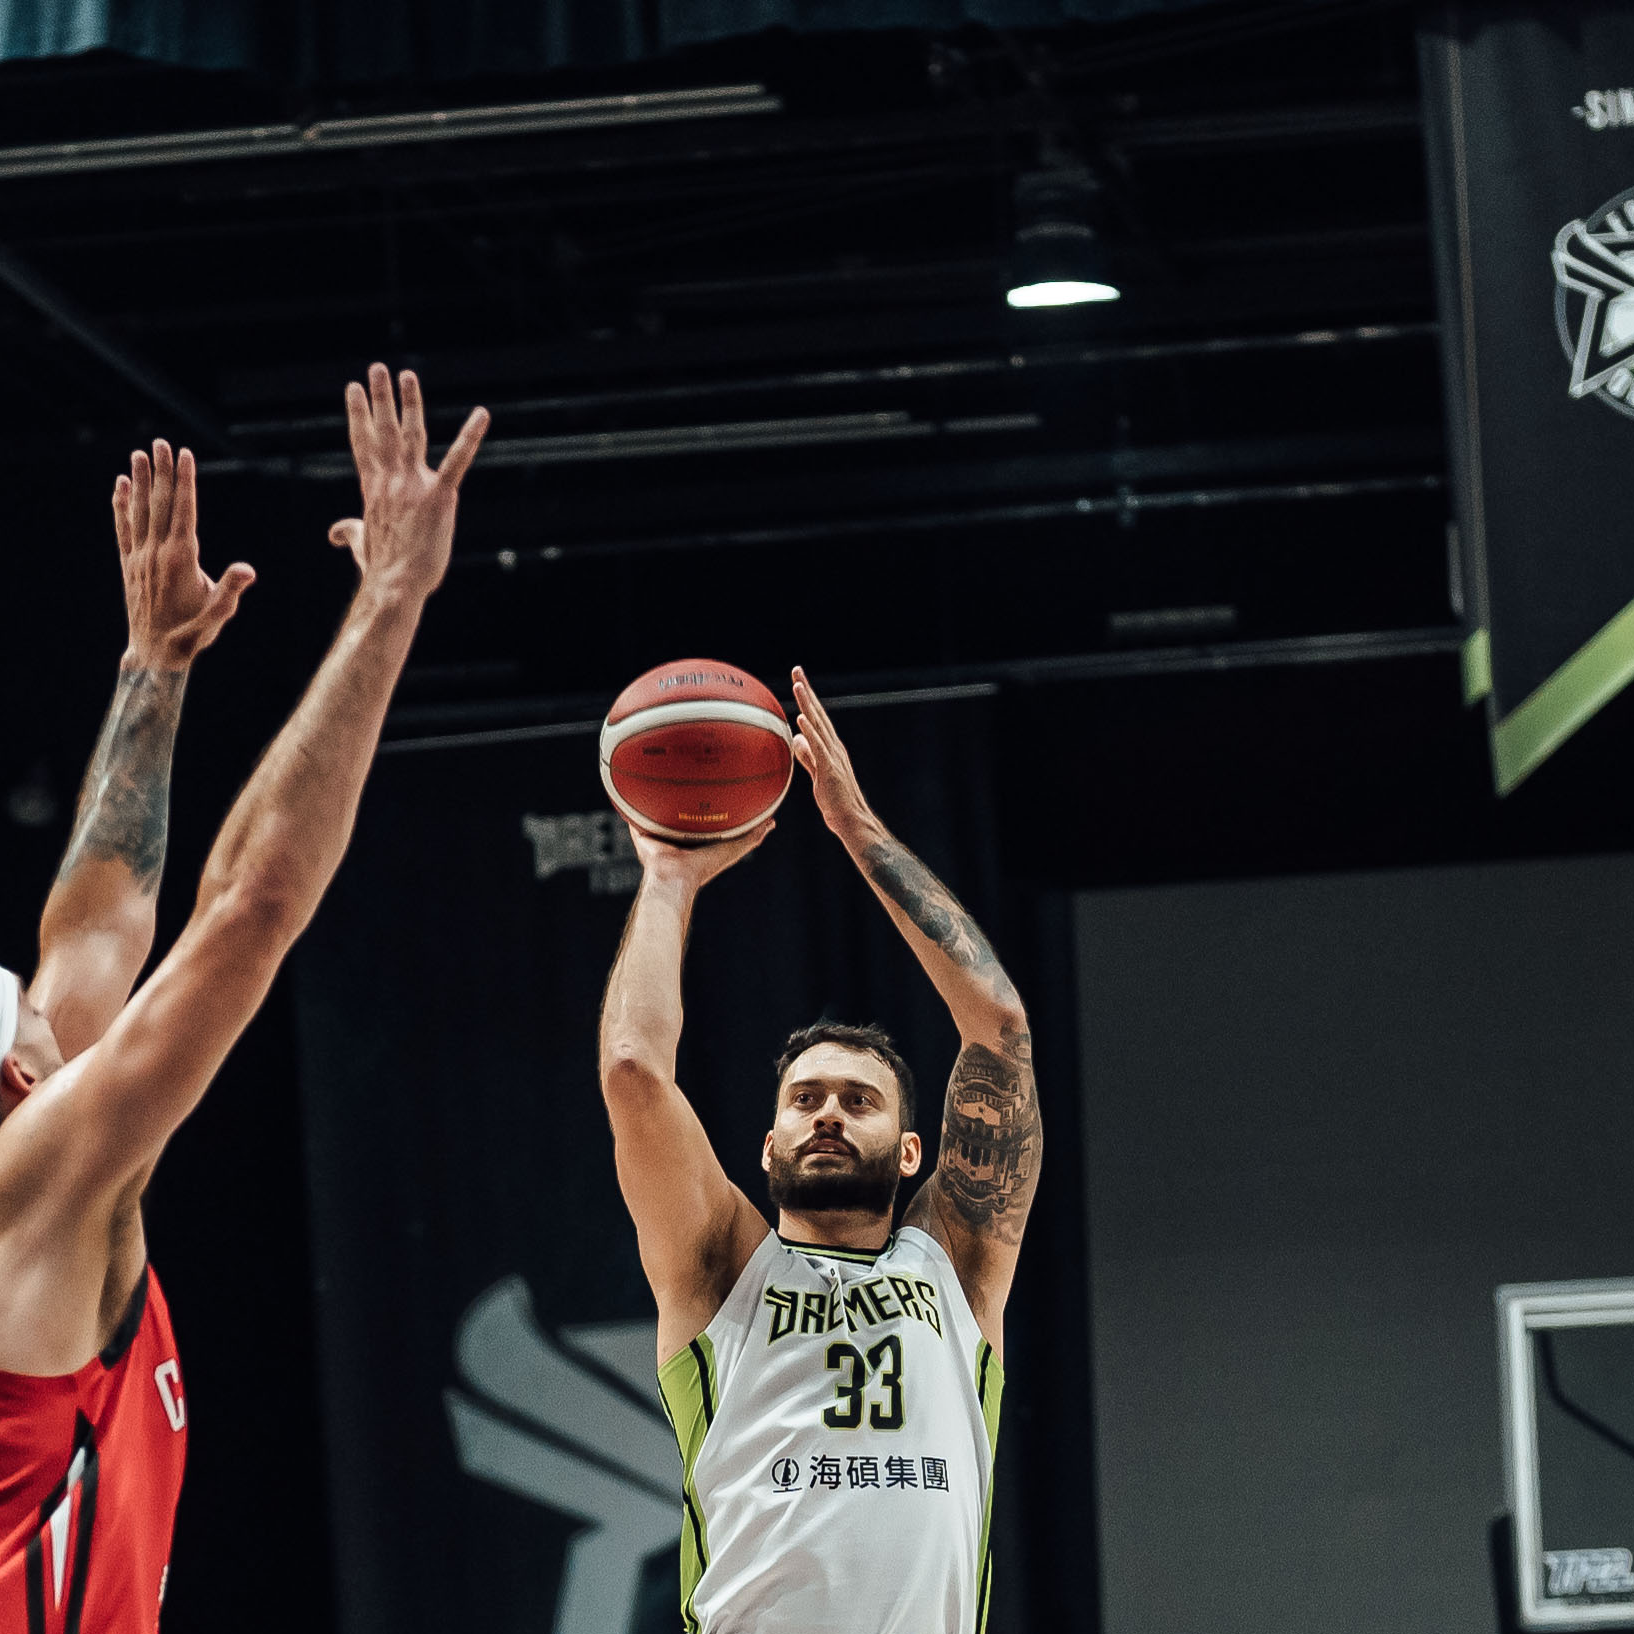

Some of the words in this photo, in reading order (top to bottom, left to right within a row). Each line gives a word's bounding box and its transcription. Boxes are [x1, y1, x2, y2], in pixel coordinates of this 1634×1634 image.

[821, 1333, 907, 1433] 33
[809, 1455, 950, 1493] 海碩集團
